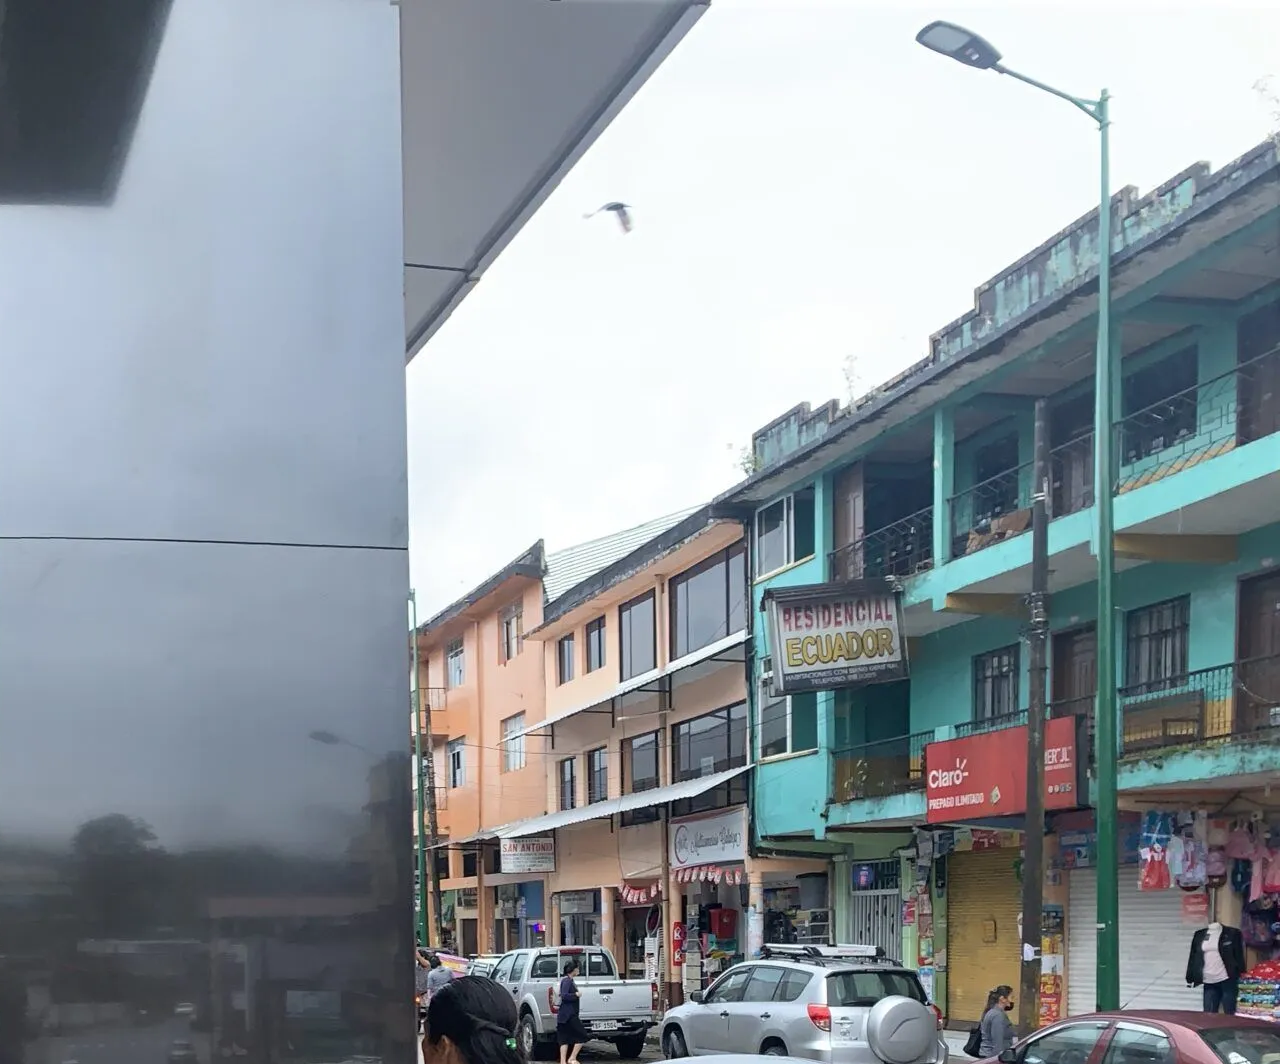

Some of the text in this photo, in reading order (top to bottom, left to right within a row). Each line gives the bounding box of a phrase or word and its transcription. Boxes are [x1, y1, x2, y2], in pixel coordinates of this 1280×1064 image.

[782, 600, 893, 632] RESIDENCIAL
[786, 627, 895, 667] ECUADOR
[928, 768, 963, 789] Claro
[929, 792, 985, 810] PREPAGO ILIMITADO
[502, 842, 553, 853] SAN ANTONIO
